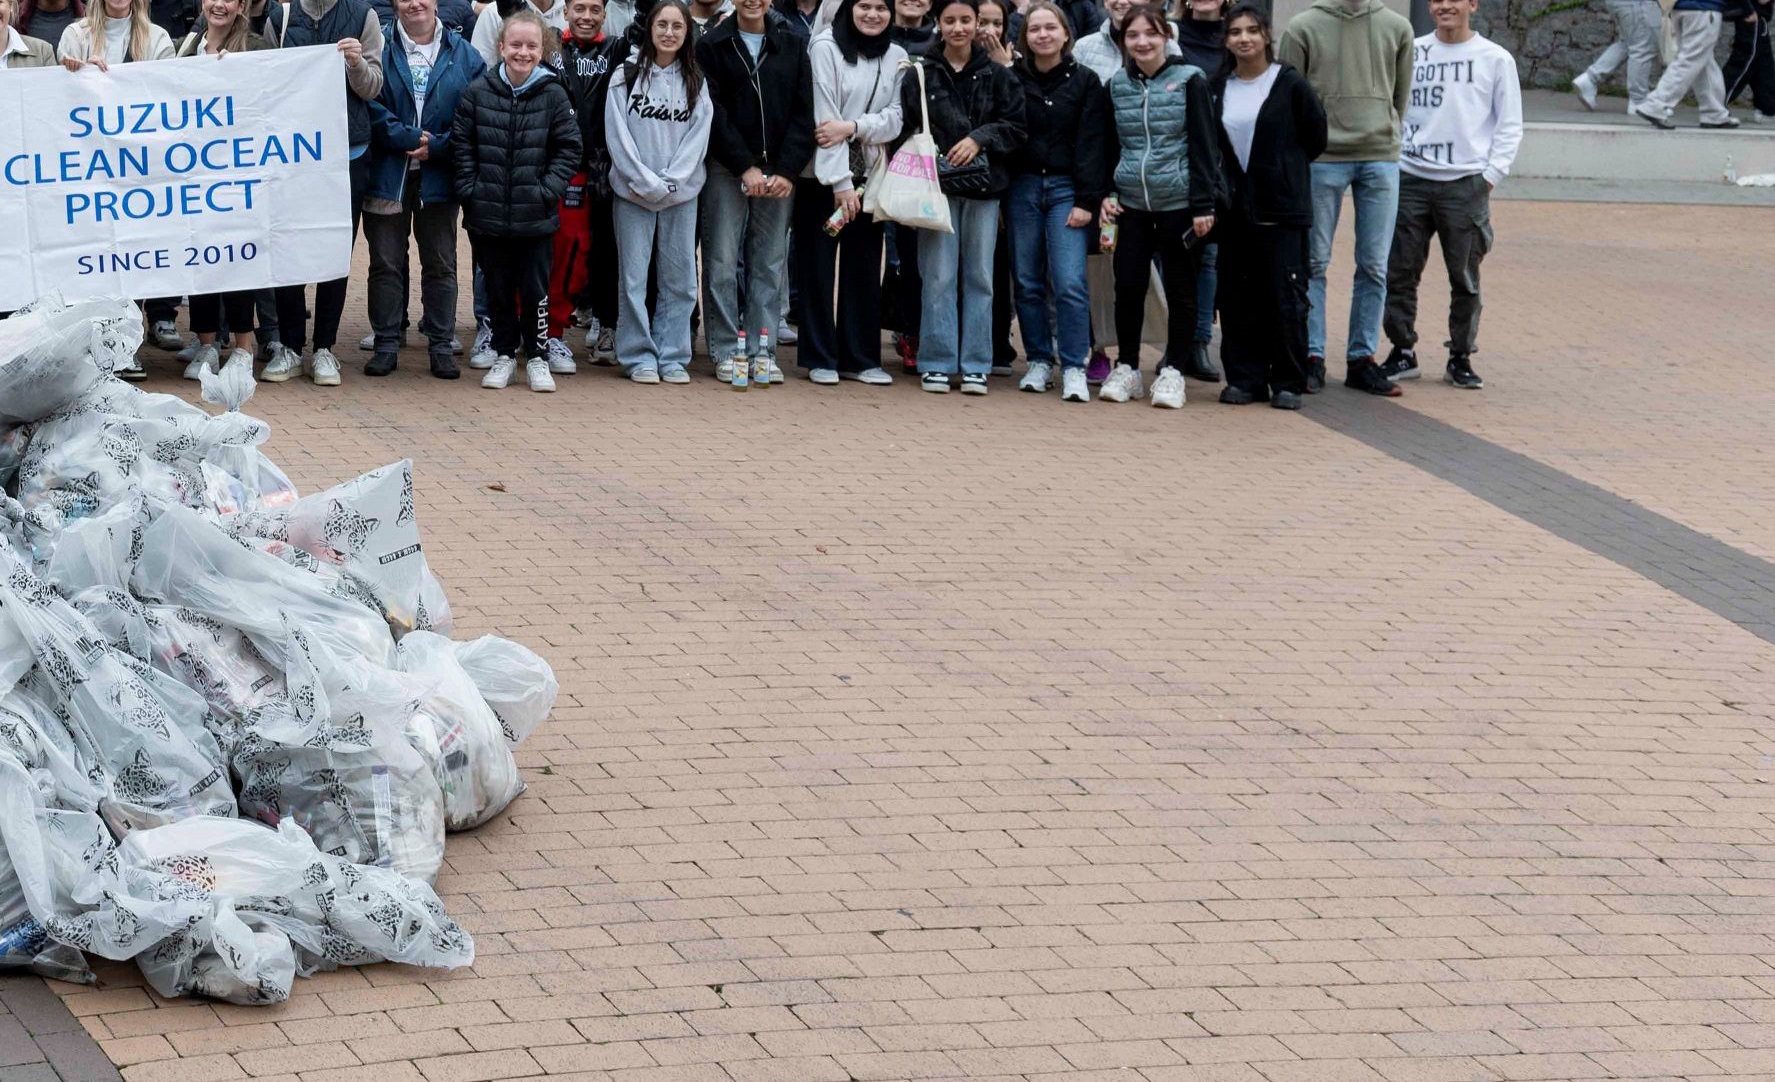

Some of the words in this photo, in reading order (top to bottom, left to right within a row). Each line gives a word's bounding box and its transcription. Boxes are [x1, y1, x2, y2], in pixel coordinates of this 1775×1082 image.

[1414, 60, 1474, 83] GOTTI
[1411, 85, 1444, 107] RIS
[69, 95, 234, 138] SUZUKI
[4, 145, 149, 186] CLEAN
[164, 131, 322, 174] OCEAN
[65, 178, 262, 225] PROJECT
[77, 249, 171, 275] SINCE
[184, 242, 257, 266] 2010
